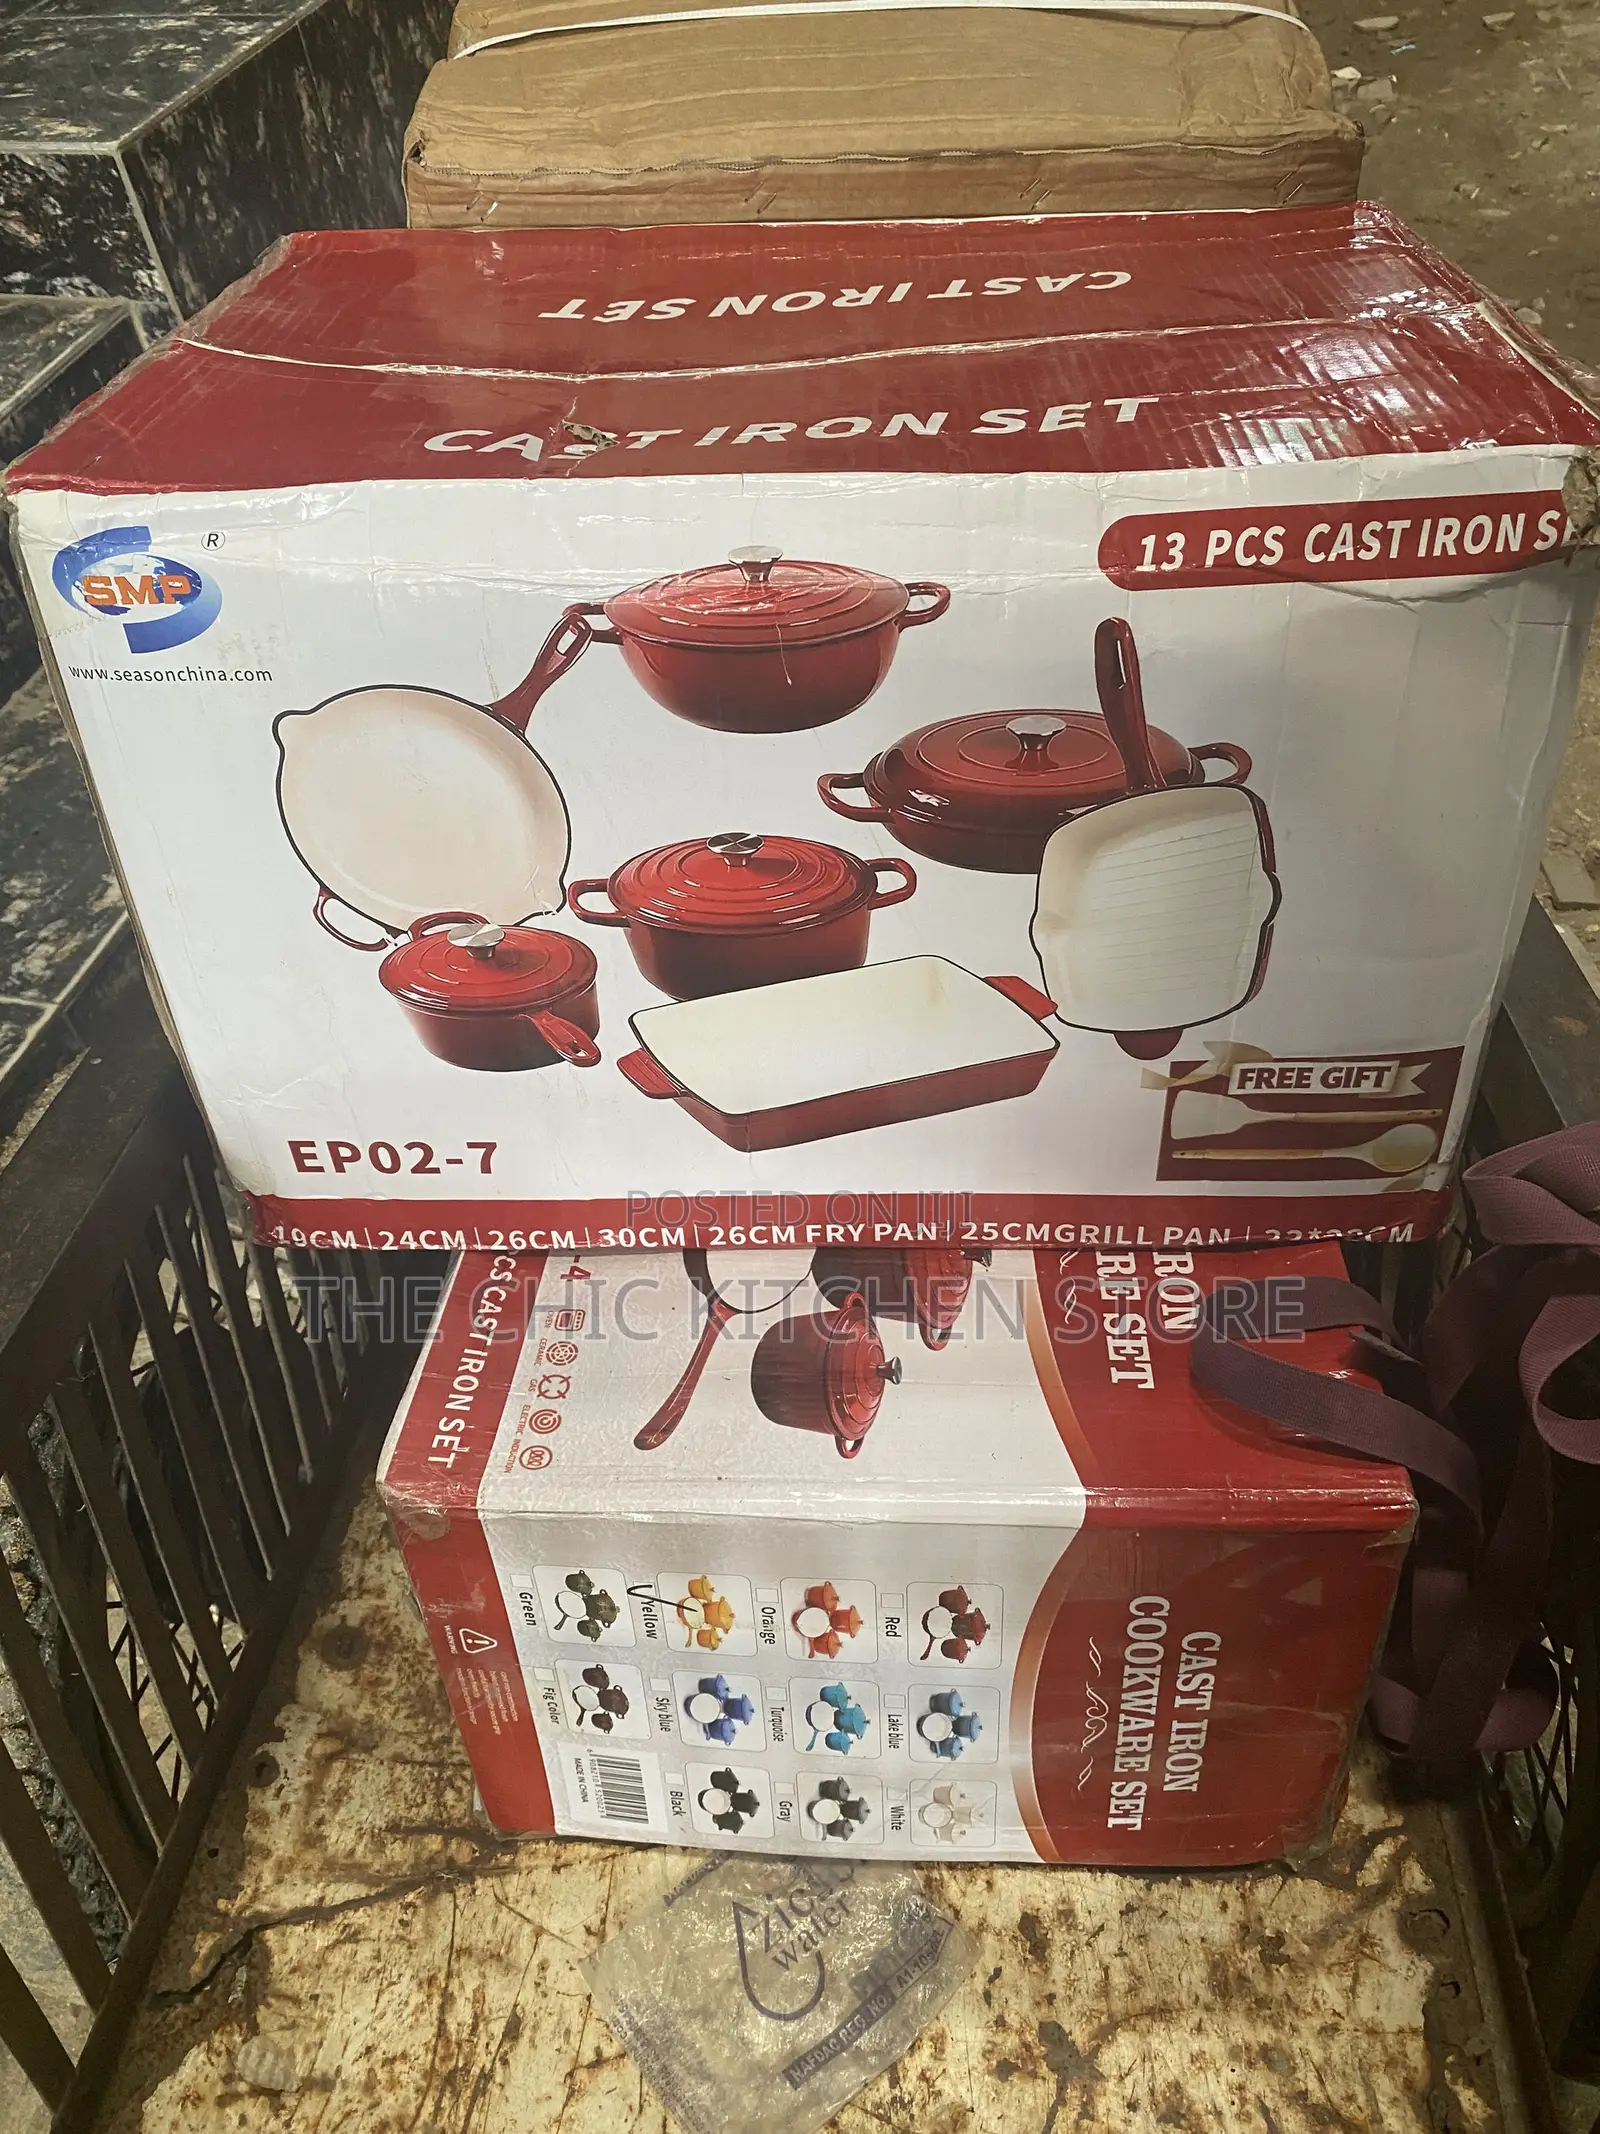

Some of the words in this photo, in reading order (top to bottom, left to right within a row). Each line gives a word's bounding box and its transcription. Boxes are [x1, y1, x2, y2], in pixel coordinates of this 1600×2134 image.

[708, 282, 915, 318] IRON
[926, 270, 1133, 299] CAST
[538, 298, 698, 323] SET
[423, 428, 683, 463] CAST
[693, 411, 949, 447] IRON
[970, 397, 1160, 436] SET
[1134, 531, 1185, 573] 13
[1203, 526, 1288, 569] PCS
[1303, 519, 1411, 563] CAST
[1417, 512, 1526, 558] IRON
[82, 574, 195, 607] SMP
[68, 663, 274, 684] www.seasonchina.com
[1237, 1066, 1314, 1090] FREE
[1320, 1065, 1392, 1089] GIFT
[288, 1140, 499, 1175] EP02-7
[273, 1225, 357, 1250] 19CM
[378, 1229, 466, 1250] 24CM
[488, 1229, 576, 1250] 26CM
[599, 1226, 686, 1248] 30CM
[709, 1225, 796, 1246] 26CM
[806, 1223, 865, 1243] FRY
[874, 1222, 938, 1242] PAN
[1163, 1226, 1231, 1246] PAN
[489, 1249, 518, 1283] CS
[1152, 1249, 1201, 1330] RON
[468, 1286, 507, 1348] CAST
[534, 1337, 547, 1366] CERAMIC
[1102, 1313, 1155, 1389] SET
[445, 1345, 489, 1413] IRON
[528, 1378, 537, 1392] GAS
[516, 1404, 531, 1435] ELECTRIC
[426, 1415, 465, 1469] SET
[504, 1438, 520, 1473] INDUCTION
[519, 1592, 537, 1627] Green
[640, 1599, 658, 1640] Yellow
[759, 1606, 776, 1646] Orange
[885, 1616, 902, 1639] Red
[1114, 1595, 1171, 1773] COOKWARE
[1174, 1631, 1222, 1711] CAST
[543, 1687, 555, 1700] Fig
[654, 1697, 670, 1715] Sky
[547, 1700, 561, 1725] Color
[659, 1713, 673, 1733] blue
[769, 1706, 785, 1743] Turquoise
[887, 1714, 902, 1732] Lake
[888, 1733, 904, 1749] blue
[1163, 1719, 1208, 1792] IRON
[574, 1758, 584, 1776] MADE
[579, 1784, 589, 1803] CHINA
[669, 1790, 684, 1817] Black
[777, 1799, 793, 1824] Gray
[890, 1805, 905, 1831] White
[1107, 1781, 1148, 1831] SET
[789, 2039, 838, 2082] NAFDAC
